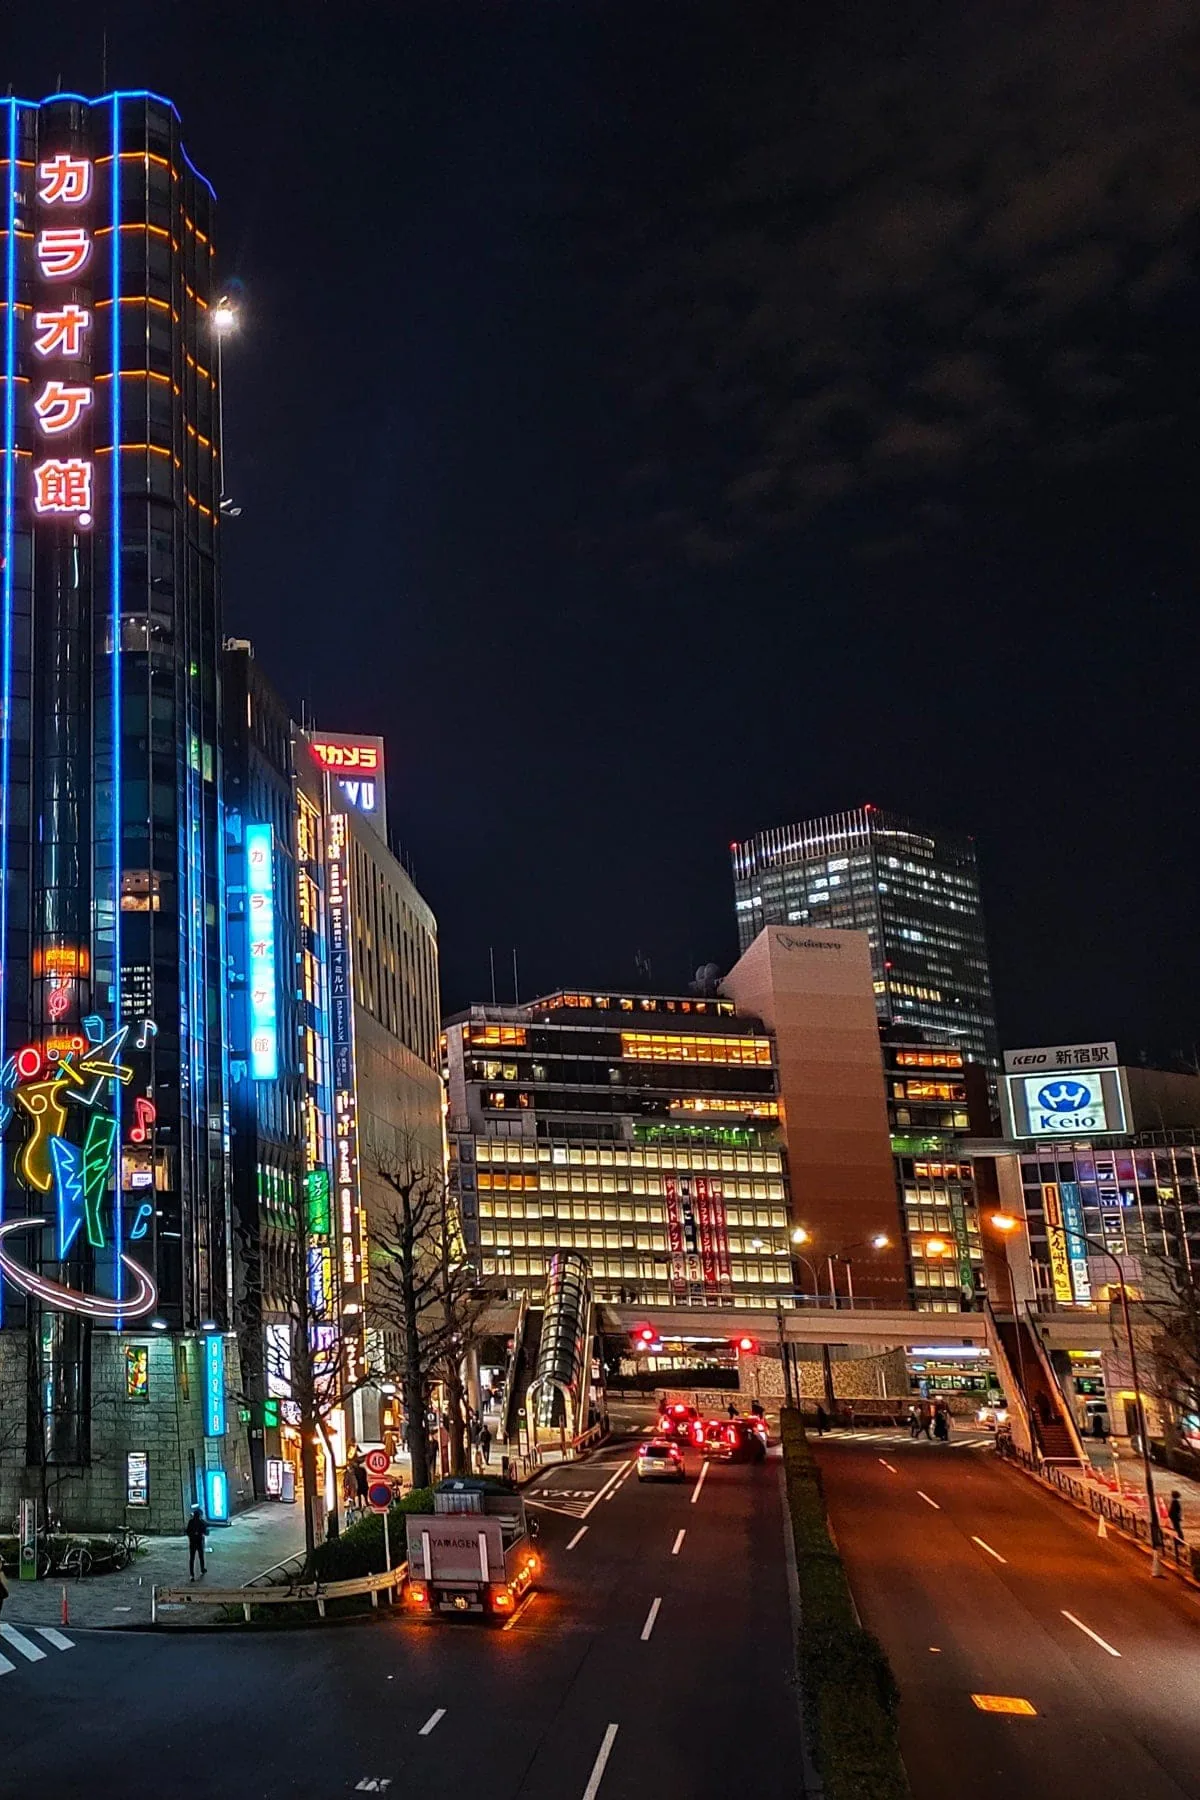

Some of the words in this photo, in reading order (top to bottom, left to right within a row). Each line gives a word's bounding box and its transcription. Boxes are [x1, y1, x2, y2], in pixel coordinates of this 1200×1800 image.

[35, 154, 91, 512] カラオケ館
[251, 850, 269, 1053] カラオケ館
[1012, 1054, 1047, 1065] KEIO
[1055, 1047, 1109, 1065] 新宿駅
[1040, 1113, 1096, 1129] Keio
[372, 1456, 384, 1467] 40
